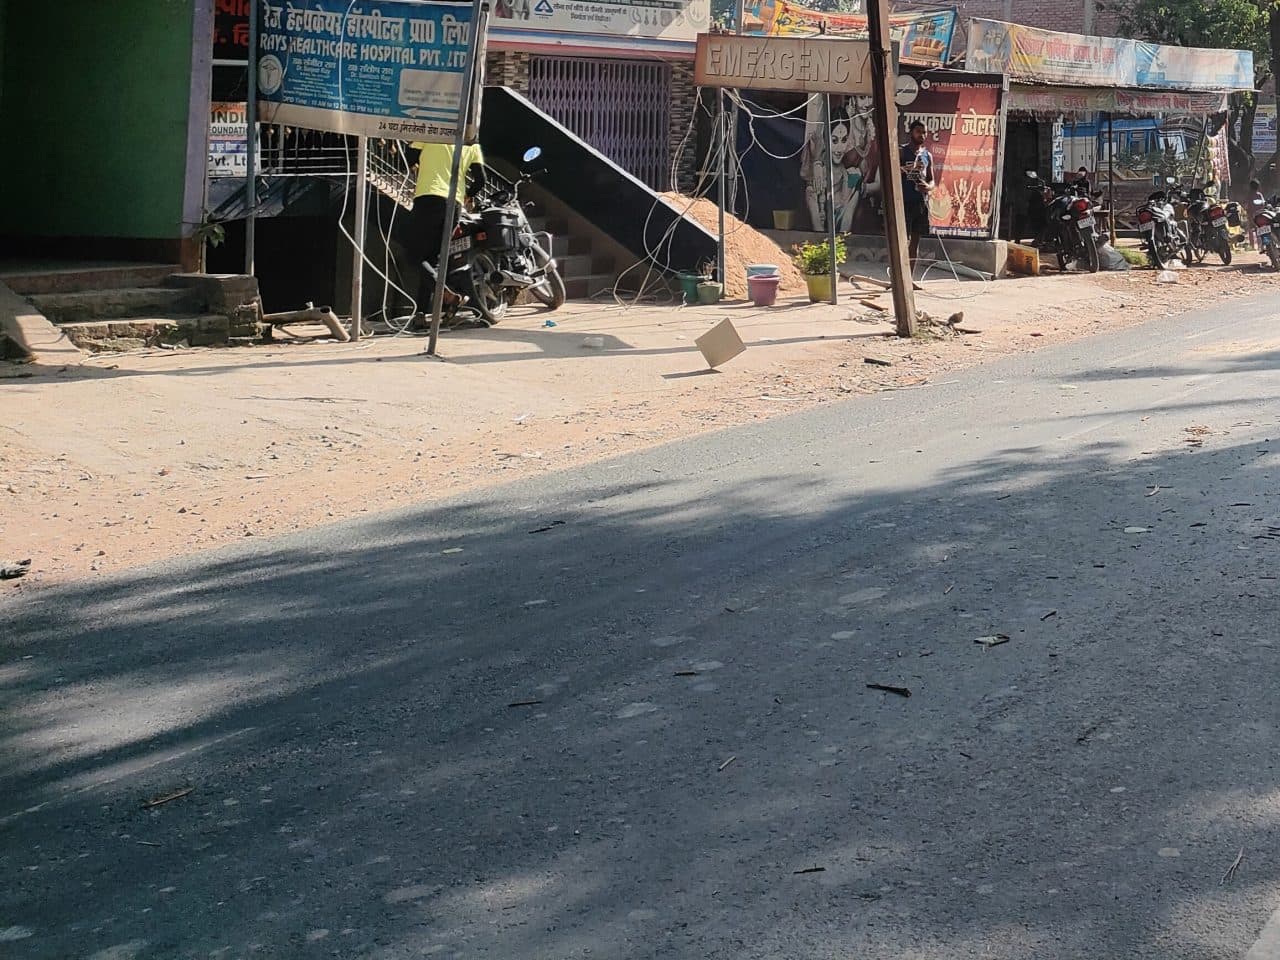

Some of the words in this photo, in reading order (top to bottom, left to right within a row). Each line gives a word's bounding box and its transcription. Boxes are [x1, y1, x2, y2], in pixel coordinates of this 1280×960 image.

[260, 33, 287, 51] RAYS
[288, 36, 358, 59] HEALTHCARE
[360, 44, 416, 65] HOSPITAL
[705, 43, 871, 84] EMERGENCY
[211, 112, 247, 124] INDI
[209, 126, 246, 135] OUNDATI
